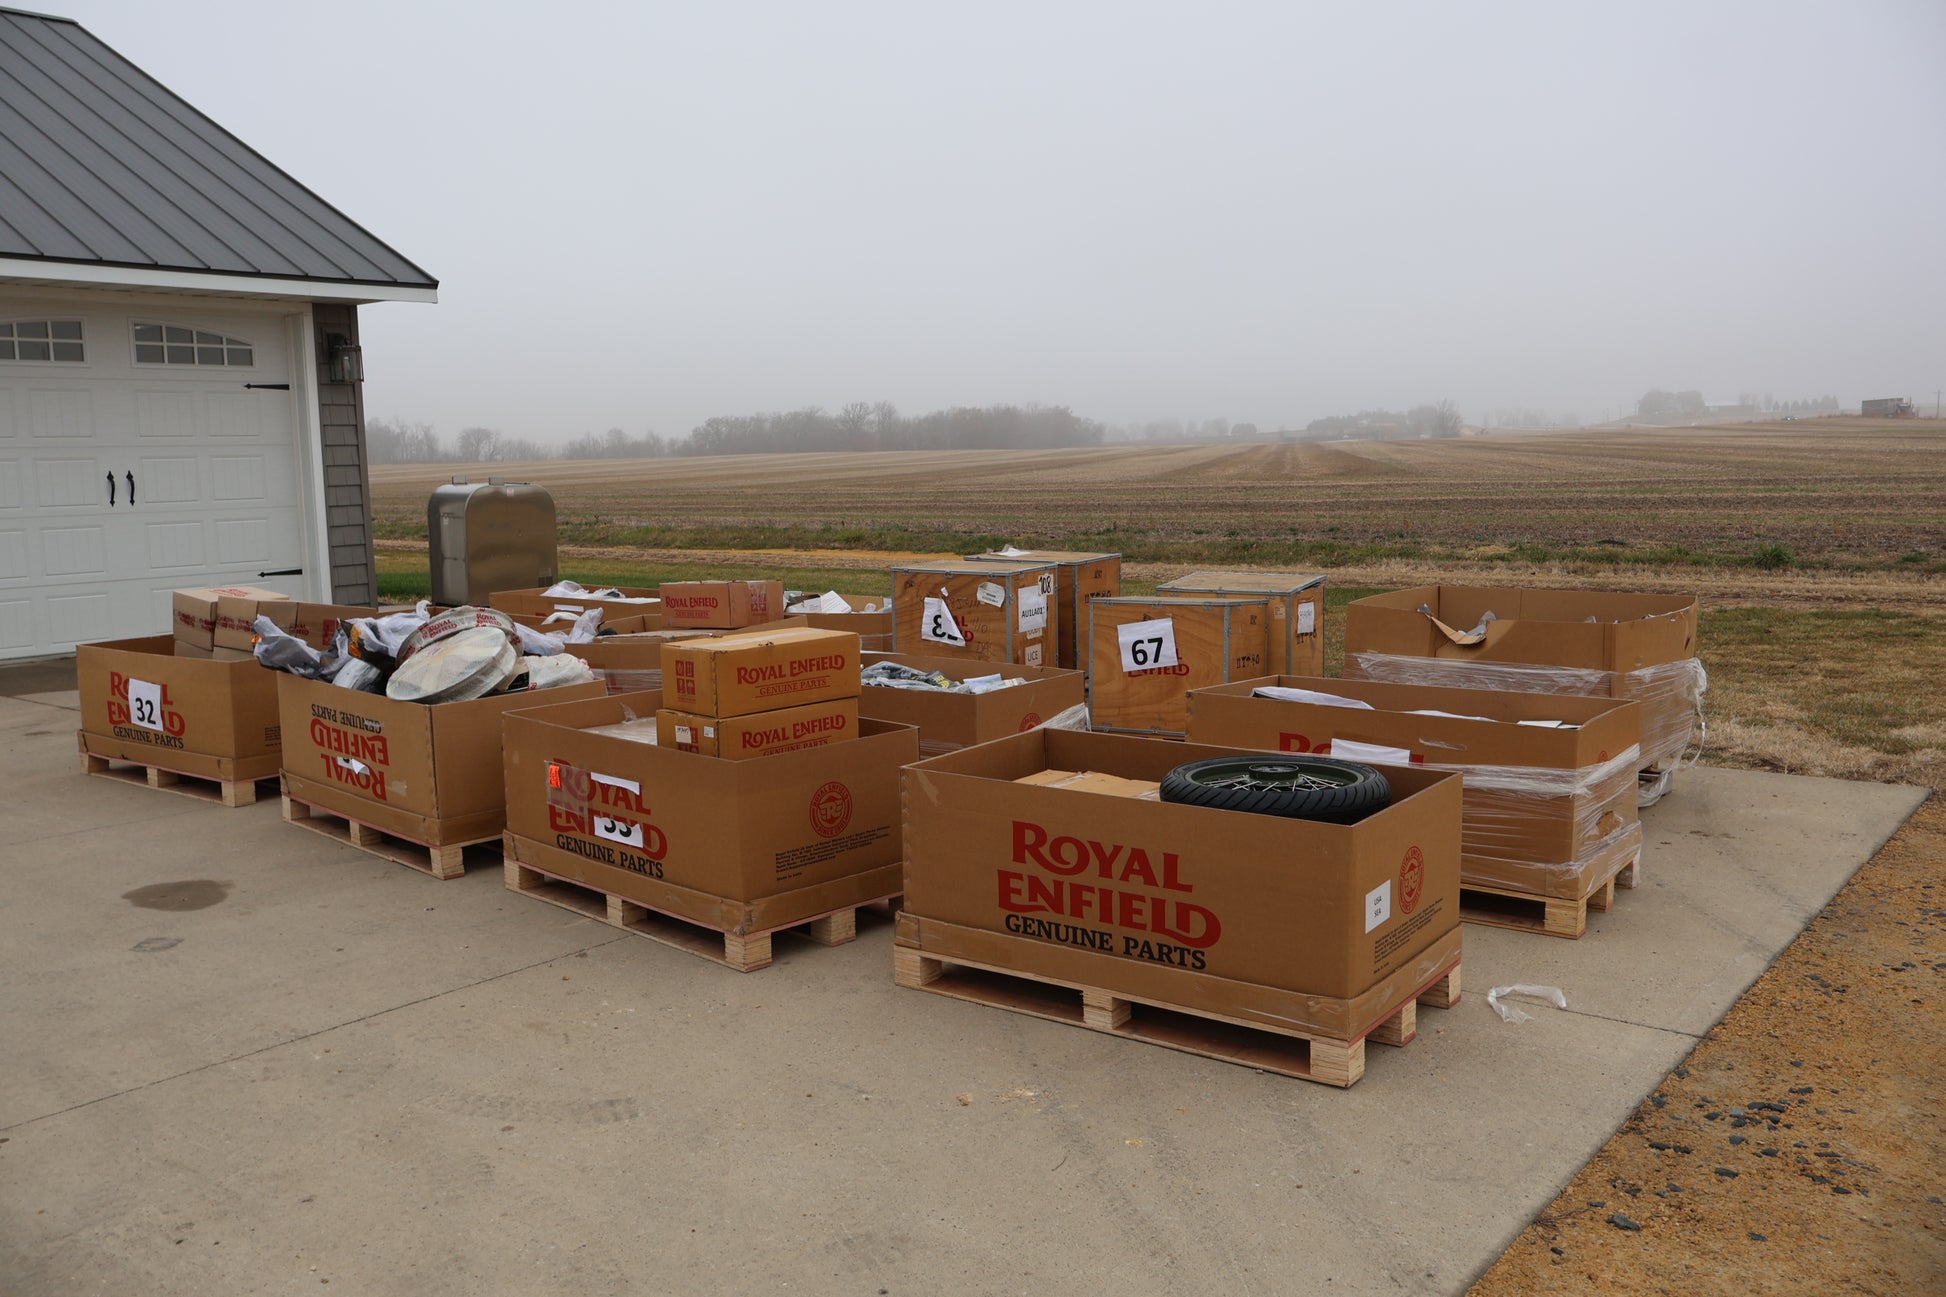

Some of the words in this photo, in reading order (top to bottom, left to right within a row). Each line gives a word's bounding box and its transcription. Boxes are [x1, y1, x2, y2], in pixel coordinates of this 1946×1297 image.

[665, 595, 689, 609] ROYAL
[690, 597, 719, 609] ENFIELD
[428, 619, 452, 632] ROYAL
[1131, 637, 1164, 666] 67
[737, 663, 787, 685] ROYAL
[789, 654, 846, 677] ENFIELD
[759, 683, 798, 696] GENUINE
[800, 677, 828, 690] PARTS
[135, 697, 156, 725] 32
[311, 703, 337, 723] PARTS
[340, 711, 382, 734] GENUINE
[113, 725, 152, 744] GENUINE
[154, 733, 184, 749] PARTS
[310, 717, 390, 766] ENFIELD
[742, 727, 789, 749] ROYAL
[793, 714, 846, 739] ENFIELD
[320, 753, 388, 801] ROYAL
[552, 757, 651, 815] ROYAL
[556, 833, 615, 864] GENUINE
[619, 850, 664, 879] PARTS
[1012, 820, 1193, 893] ROYAL
[997, 869, 1222, 949] ENFIELD
[1005, 913, 1113, 952] GENUINE
[1123, 935, 1206, 971] PARTS
